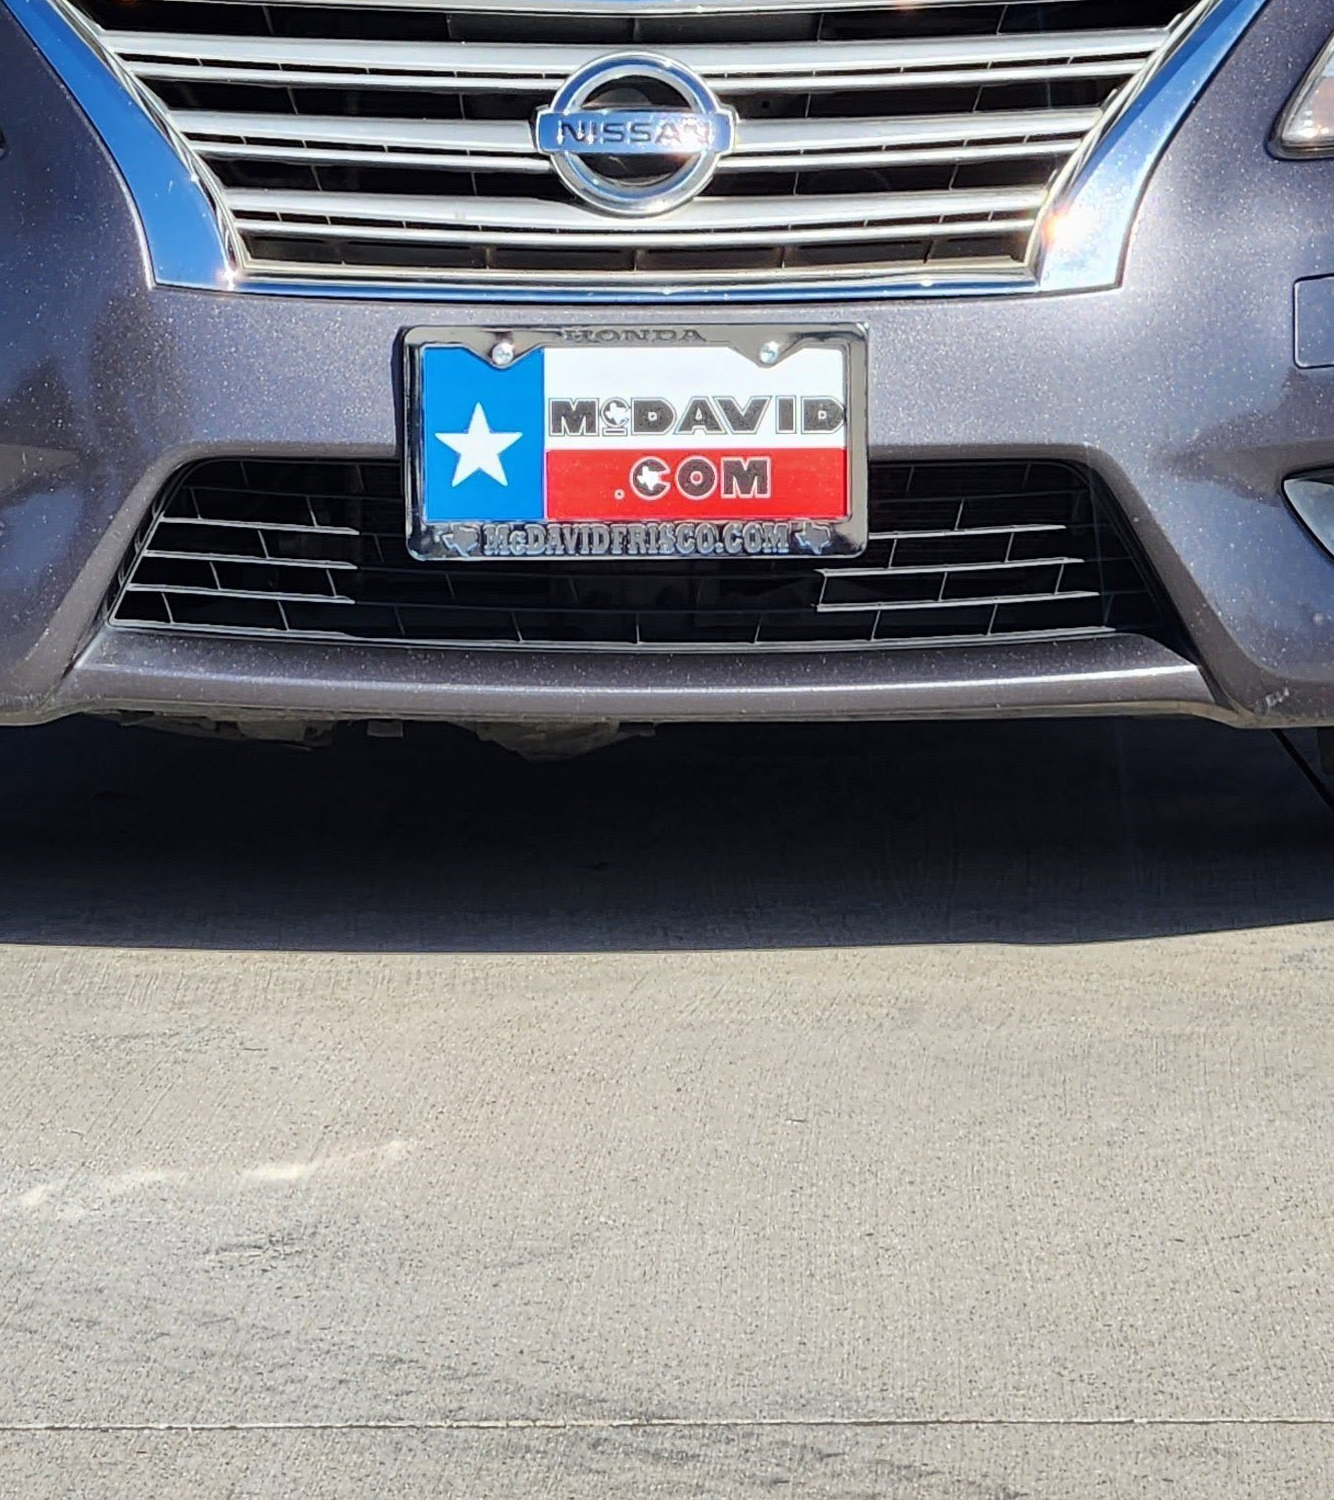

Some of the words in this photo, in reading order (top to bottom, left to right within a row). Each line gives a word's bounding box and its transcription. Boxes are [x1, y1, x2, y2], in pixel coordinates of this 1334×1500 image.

[556, 119, 712, 146] NISSAN
[562, 328, 707, 343] HONDA
[615, 456, 771, 500] .COM
[482, 523, 790, 555] McDAVIDFRISCO.COM
